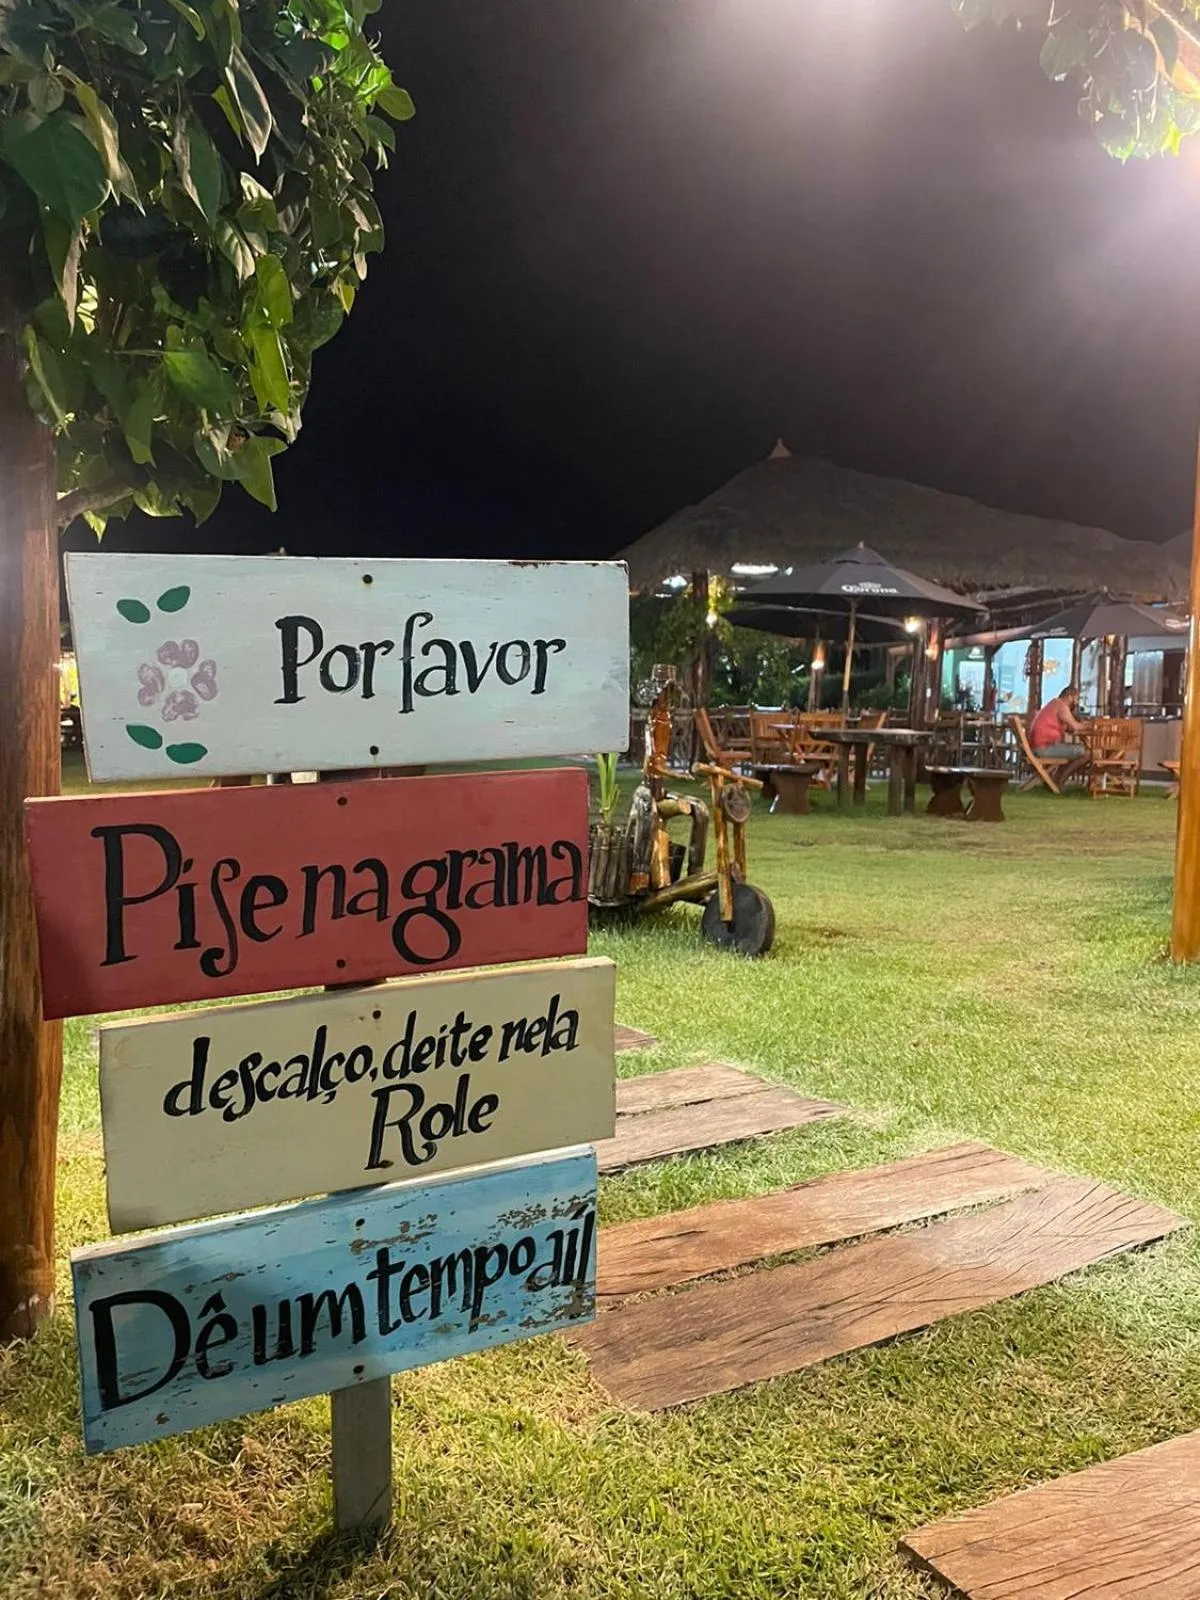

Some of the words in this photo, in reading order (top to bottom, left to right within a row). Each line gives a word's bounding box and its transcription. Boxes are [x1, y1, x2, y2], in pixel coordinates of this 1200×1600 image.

[274, 615, 394, 704] Por
[398, 611, 566, 714] favor
[91, 823, 289, 977] Pise
[296, 857, 391, 938] na
[392, 840, 584, 965] grama
[163, 1025, 378, 1122] descalço,
[382, 1010, 492, 1080] deite
[498, 993, 580, 1062] nela
[364, 1073, 499, 1170] Role
[89, 1290, 239, 1410] Dê
[252, 1282, 366, 1365] um
[366, 1246, 536, 1334] tempo
